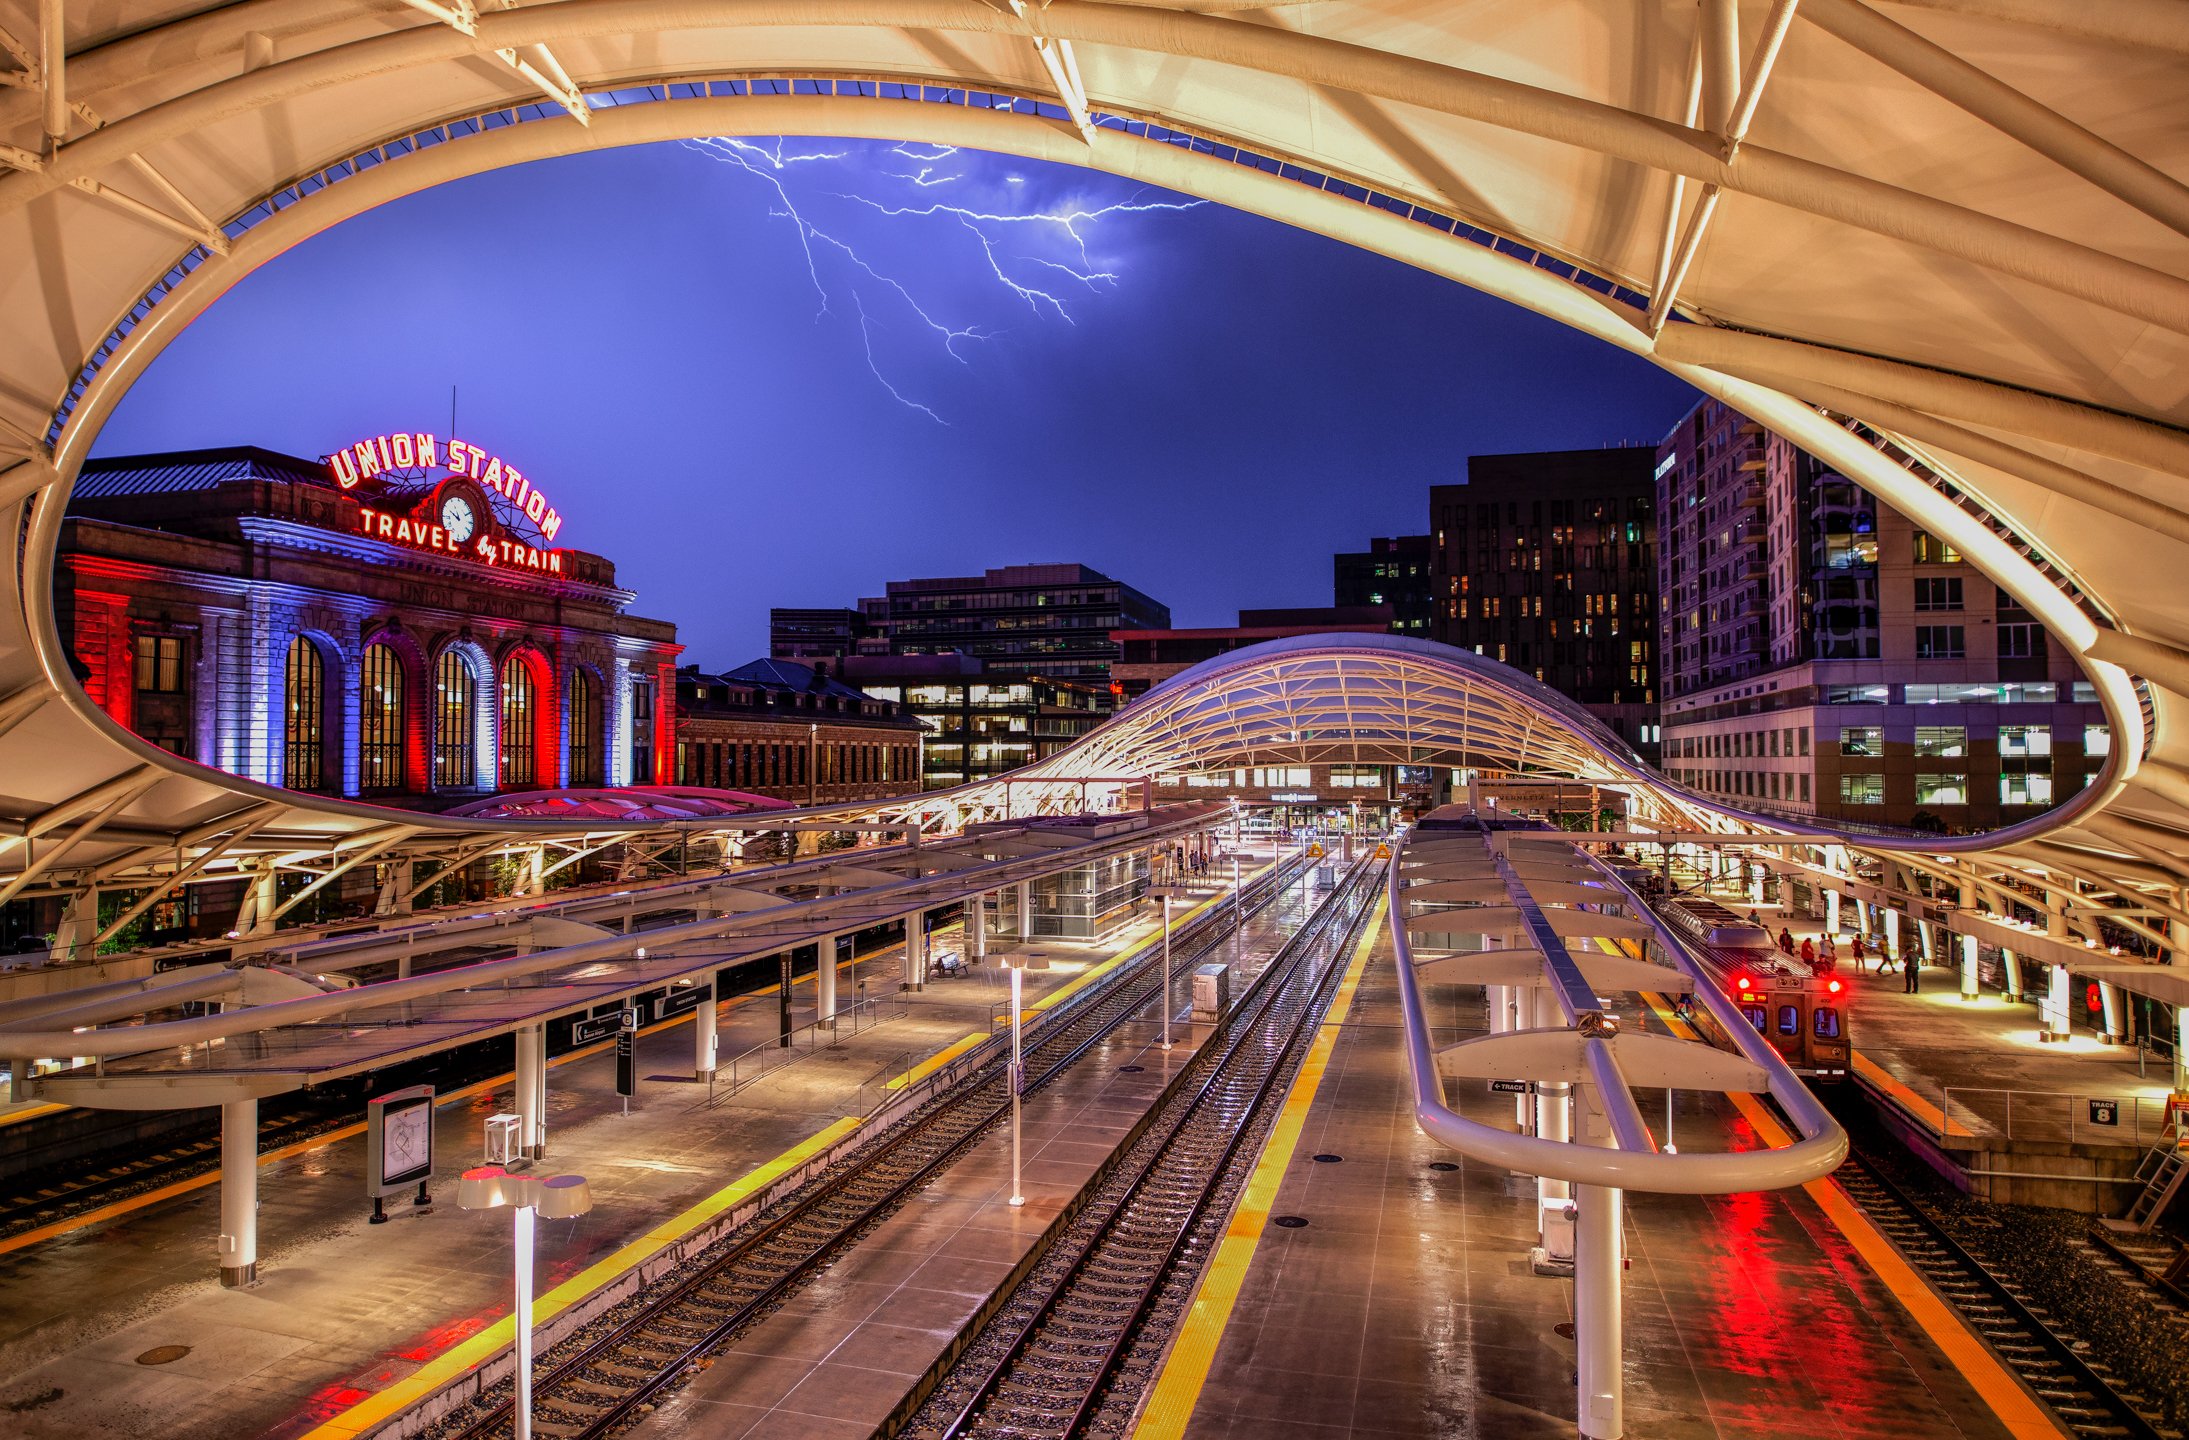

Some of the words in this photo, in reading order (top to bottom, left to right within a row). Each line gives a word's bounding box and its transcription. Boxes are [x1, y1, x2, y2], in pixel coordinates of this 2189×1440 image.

[331, 432, 436, 489] UNION
[448, 439, 562, 542] STATION
[360, 508, 459, 551] TRAVEL
[476, 534, 497, 566] by
[500, 541, 561, 573] TRAIN
[400, 583, 453, 606] UNION
[466, 595, 525, 617] STATION
[1501, 1083, 1524, 1091] TRACK
[2091, 1101, 2115, 1109] TRACK
[2097, 1109, 2110, 1121] 8
